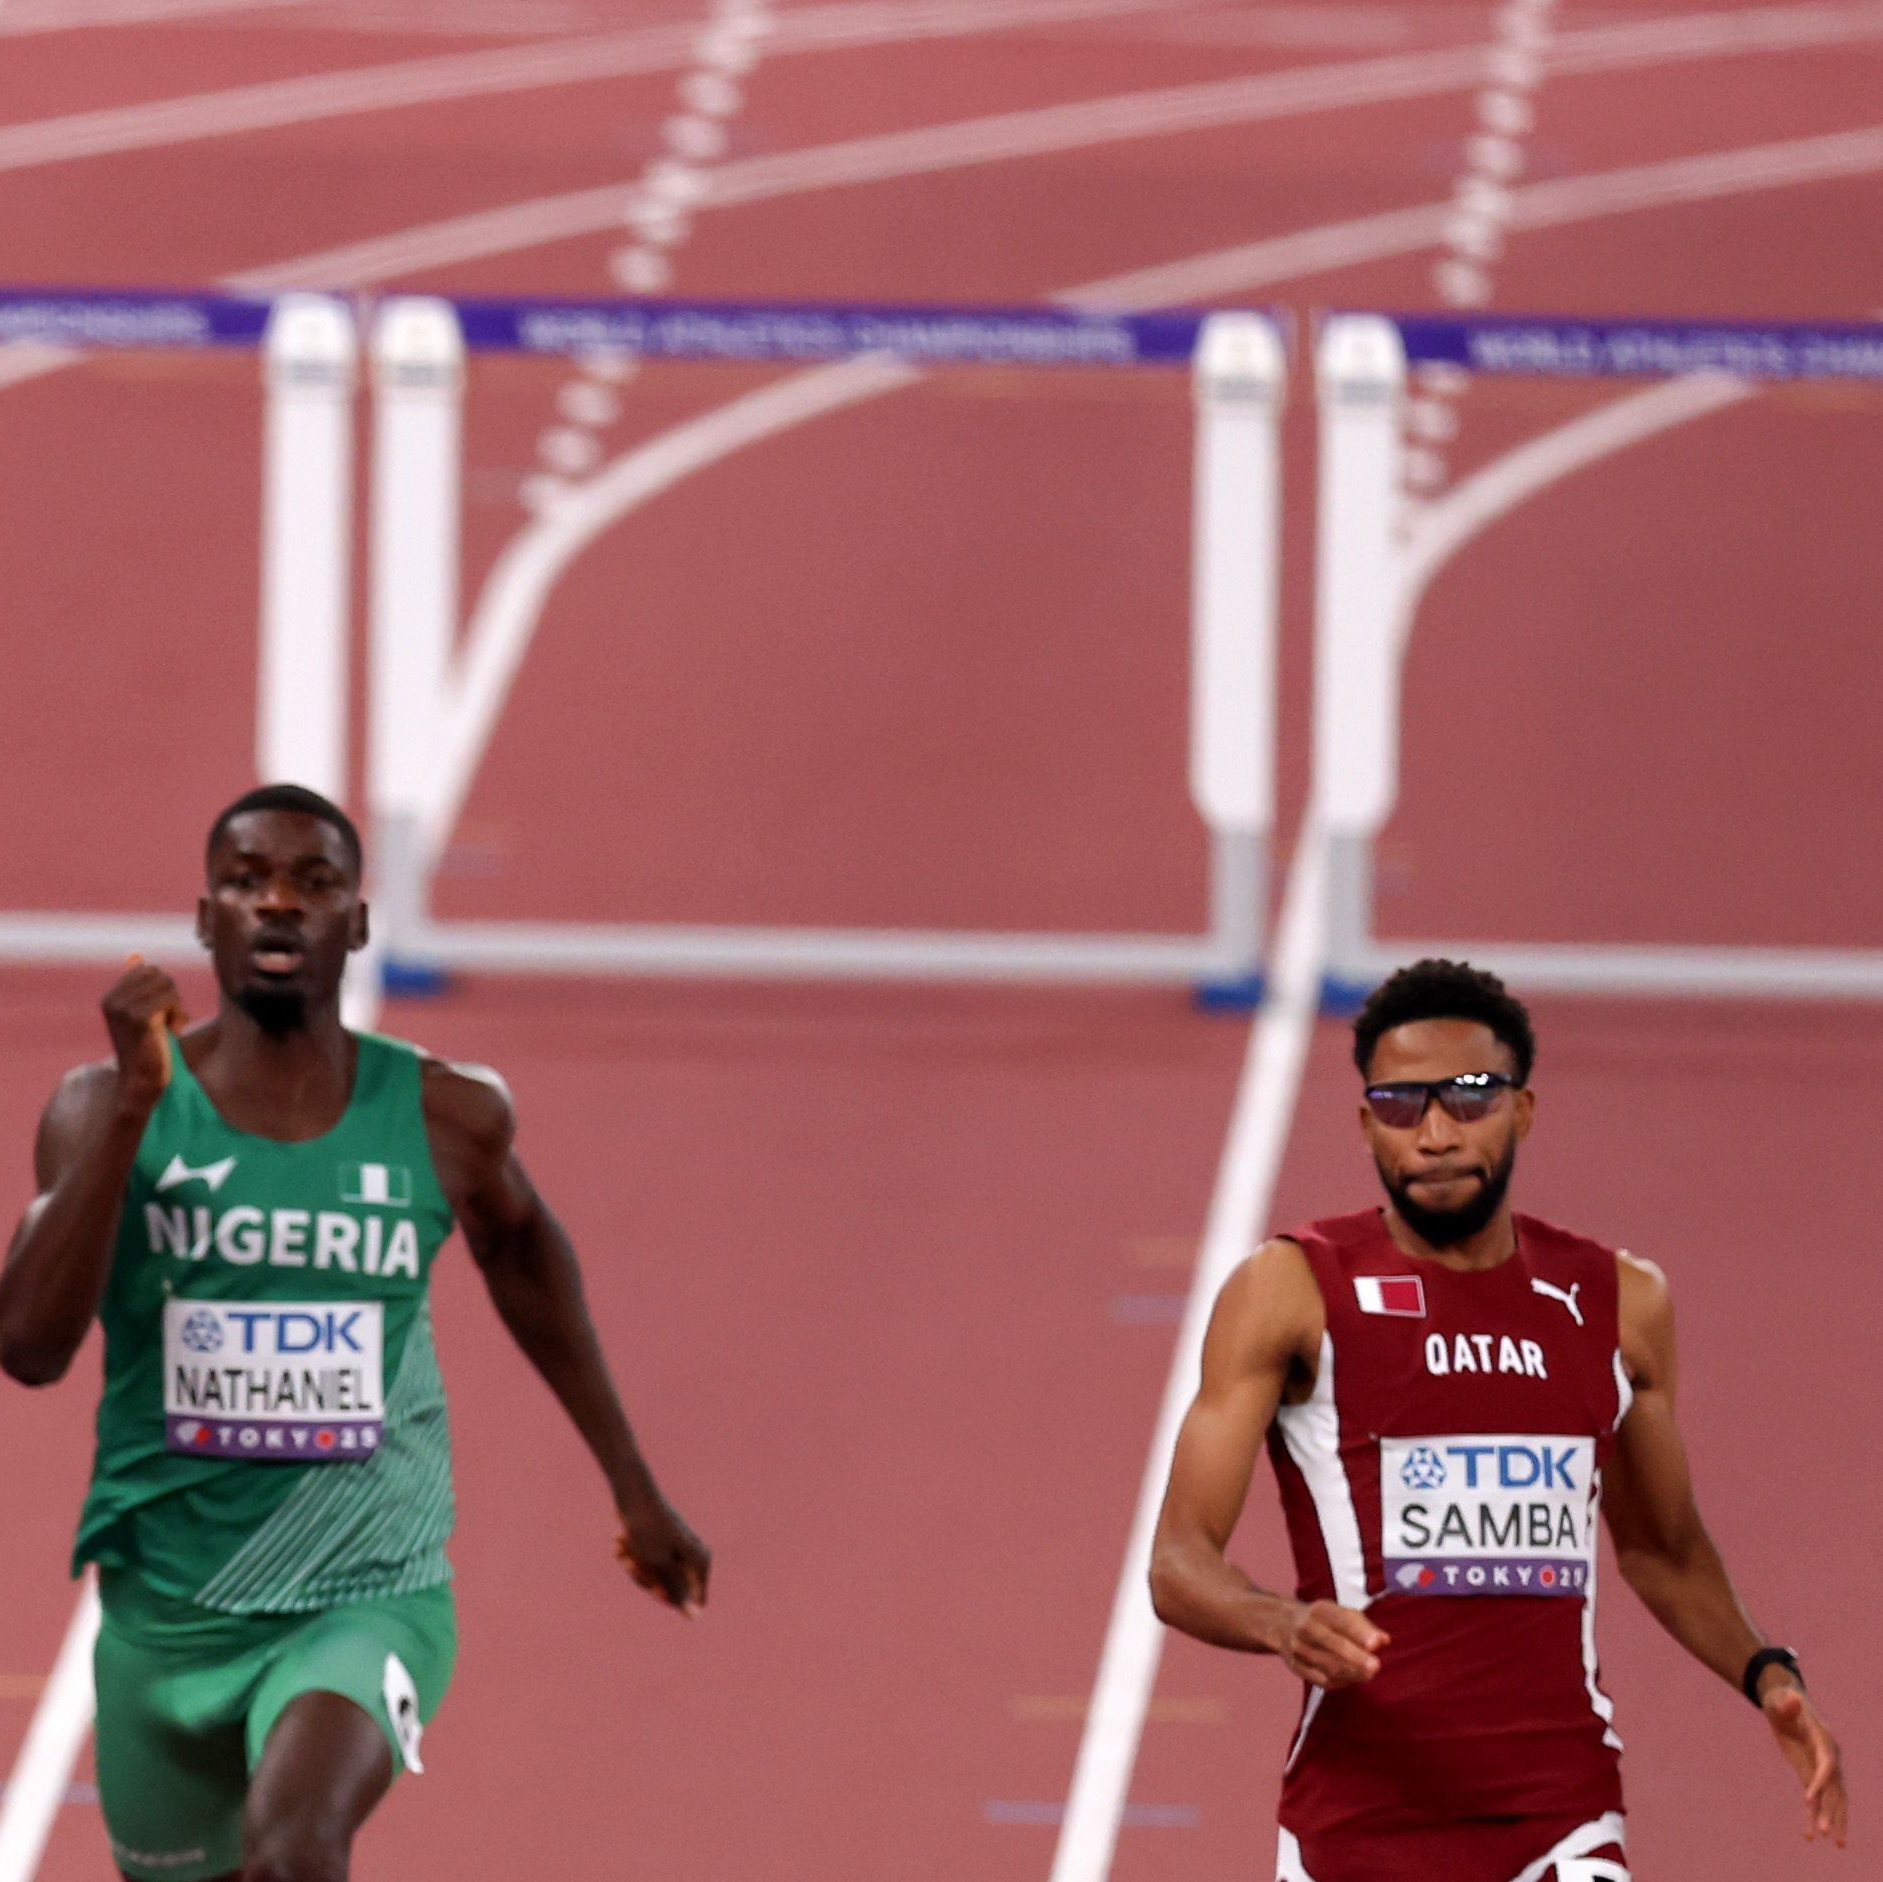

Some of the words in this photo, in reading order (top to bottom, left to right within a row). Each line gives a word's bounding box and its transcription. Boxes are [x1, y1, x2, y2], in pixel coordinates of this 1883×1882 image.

[145, 1202, 420, 1279] NIGERIA
[228, 1311, 362, 1354] TDK
[1425, 1333, 1548, 1380] QATAR
[1447, 1445, 1578, 1490] TDK
[1401, 1503, 1577, 1549] SAMBA
